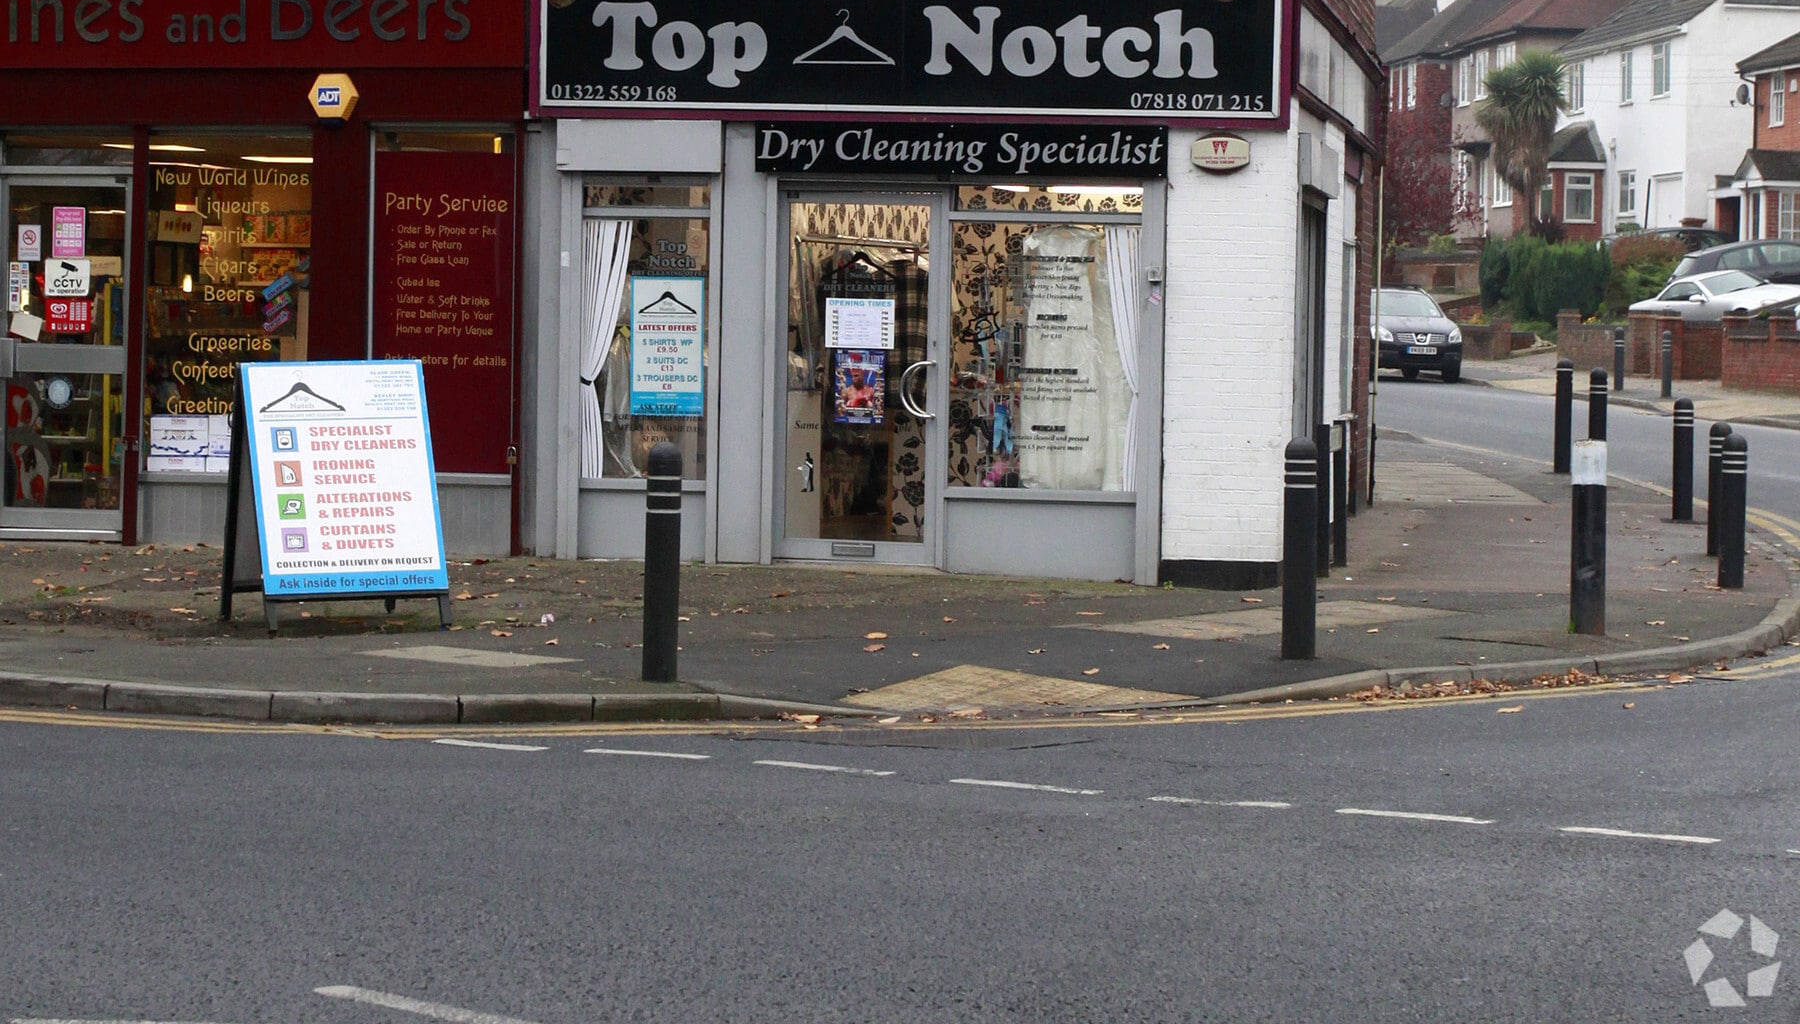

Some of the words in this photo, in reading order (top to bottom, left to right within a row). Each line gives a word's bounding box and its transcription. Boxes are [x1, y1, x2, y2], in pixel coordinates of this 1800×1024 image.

[592, 1, 768, 88] Top
[923, 5, 1219, 79] Notch
[318, 89, 340, 105] ADT
[551, 84, 605, 100] 01322
[609, 85, 641, 101] 559
[647, 85, 677, 101] 168
[1130, 92, 1187, 109] 07818
[1191, 93, 1224, 110] 071
[1231, 94, 1264, 111] 215
[757, 129, 825, 170] Dry
[834, 129, 987, 173] Cleaning
[997, 131, 1163, 174] Specialist
[156, 168, 191, 191] New
[199, 169, 247, 186] World
[253, 168, 309, 190] Wines
[194, 197, 270, 219] Liqueurs
[385, 192, 432, 216] Party
[437, 194, 508, 217] Service
[203, 227, 257, 245] pirits
[397, 225, 421, 234] Order
[425, 225, 436, 236] By
[439, 225, 466, 236] Phone
[469, 227, 479, 235] or
[482, 226, 497, 237] Fax
[396, 239, 416, 251] Sale
[419, 241, 429, 249] or
[432, 240, 462, 252] Return
[657, 239, 687, 255] Top
[397, 254, 417, 266] Free
[420, 254, 445, 265] Glass
[448, 255, 469, 267] Loan
[649, 256, 696, 269] Notch
[203, 257, 257, 281] Cigars
[53, 279, 83, 288] CCTV
[397, 277, 423, 289] Cubed
[845, 284, 896, 292] CLEANERS
[204, 286, 255, 302] Beers
[397, 294, 423, 304] Water
[428, 295, 435, 304] &
[438, 295, 457, 308] Soft
[461, 296, 490, 307] Drinks
[396, 309, 416, 320] Free
[420, 309, 457, 322] Delivery
[461, 310, 470, 322] To
[473, 311, 494, 321] Your
[396, 324, 421, 336] Home
[425, 325, 434, 333] or
[438, 325, 461, 337] Party
[465, 325, 493, 336] Venue
[188, 332, 272, 352] Groceries
[421, 355, 449, 365] store
[453, 355, 469, 369] for
[473, 356, 507, 367] details
[309, 425, 393, 438] SPECIALIST
[794, 420, 820, 430] Same
[311, 441, 339, 452] DRY
[344, 439, 417, 451] CLEANERS
[312, 459, 376, 470] IRONING
[314, 473, 377, 485] SERVICE
[316, 491, 412, 504] ALTERATIONS
[318, 509, 329, 518] &
[333, 506, 395, 518] REPAIRS
[320, 524, 396, 536] CURTAINS
[321, 541, 332, 550] &
[336, 538, 395, 550] DUVETS
[276, 560, 329, 569] COLLECTION
[340, 559, 379, 567] DELIVERY
[381, 558, 393, 566] ON
[396, 557, 433, 566] REQUEST
[279, 578, 300, 589] Ask
[303, 578, 337, 588] inside
[340, 577, 355, 587] for
[359, 576, 398, 590] special
[402, 575, 435, 585] offers
